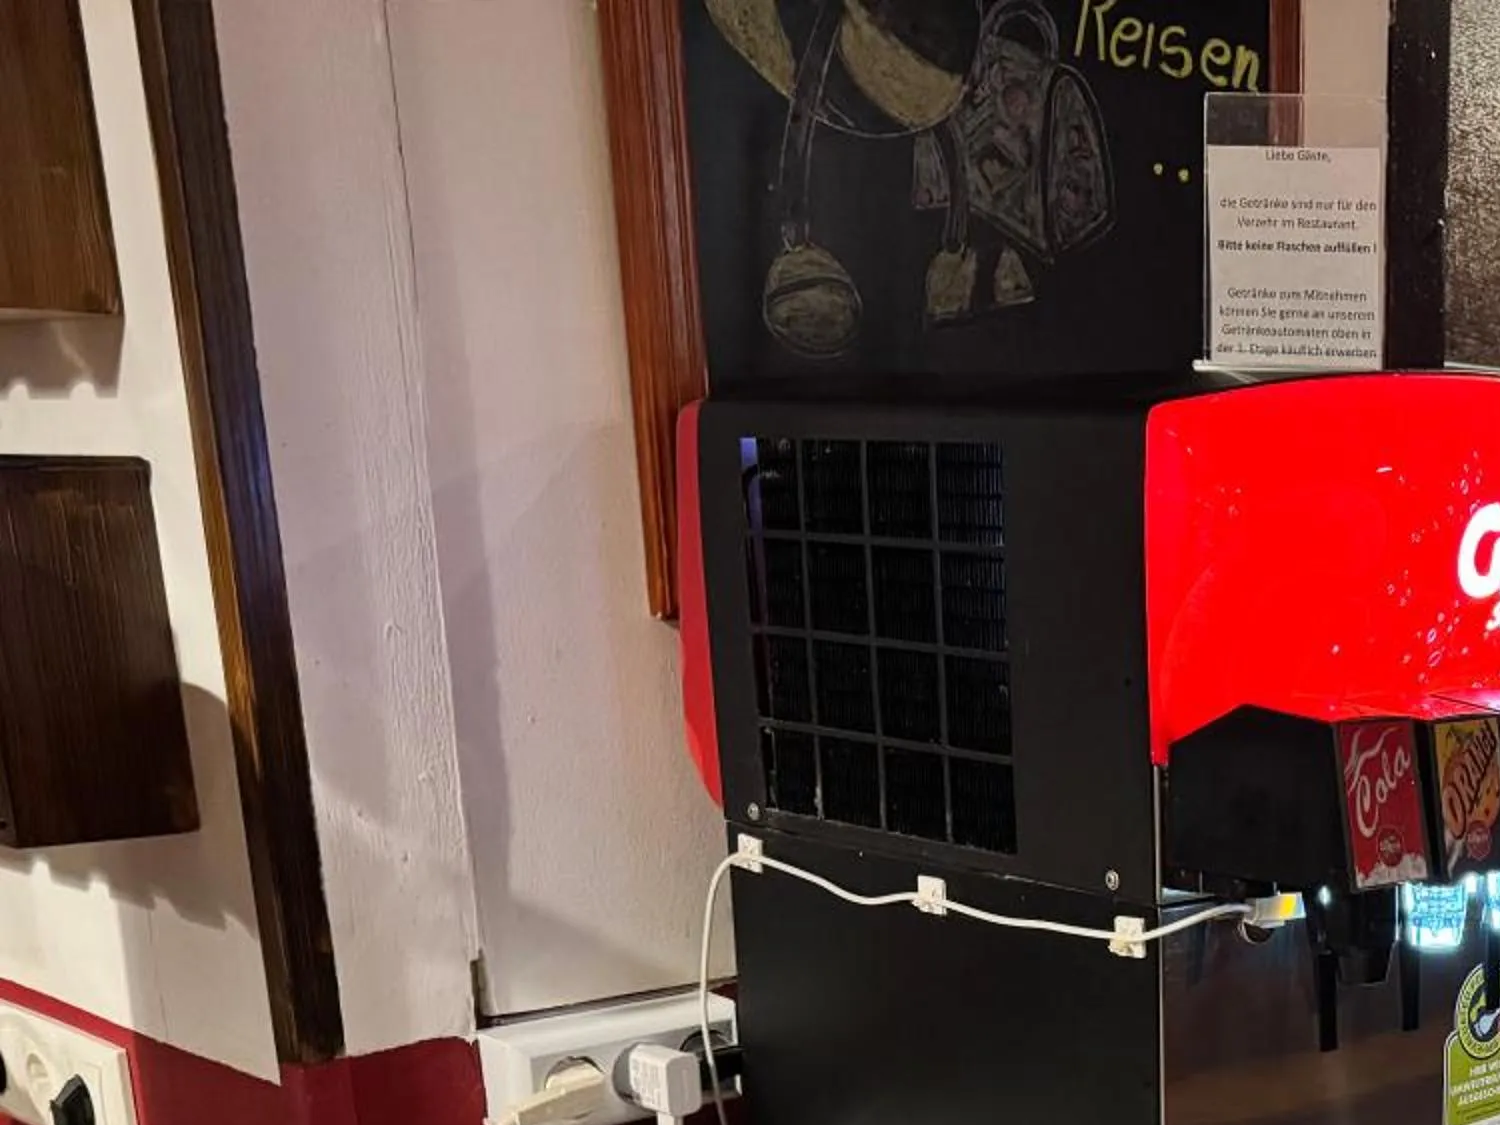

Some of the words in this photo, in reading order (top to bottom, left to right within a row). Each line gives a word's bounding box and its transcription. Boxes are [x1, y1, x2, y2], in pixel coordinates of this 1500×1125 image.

[1265, 149, 1295, 161] Liebe
[1297, 149, 1332, 163] Gäste,
[1219, 197, 1237, 208] die
[1239, 197, 1289, 209] Getränke
[1291, 198, 1313, 210] sind
[1316, 201, 1334, 210] nur
[1337, 199, 1353, 211] für
[1355, 199, 1377, 211] den
[1237, 216, 1277, 228] Verzehr
[1281, 217, 1295, 228] im
[1217, 239, 1243, 251] Bitte
[1245, 239, 1274, 251] keine
[1276, 241, 1321, 252] Flaschen
[1227, 287, 1277, 299] Getränke
[1279, 290, 1301, 301] zum
[1303, 289, 1367, 302] Mitnehmen
[1219, 305, 1259, 318] können
[1261, 307, 1277, 318] Sie
[1279, 308, 1309, 321] gerne
[1311, 310, 1325, 319] an
[1327, 310, 1375, 321] unserem
[1221, 324, 1329, 339] Getränkeautomaten
[1331, 327, 1359, 339] oben
[1361, 328, 1372, 339] in
[1216, 342, 1233, 353] der
[1249, 343, 1279, 356] Etage
[1355, 745, 1411, 838] Cola
